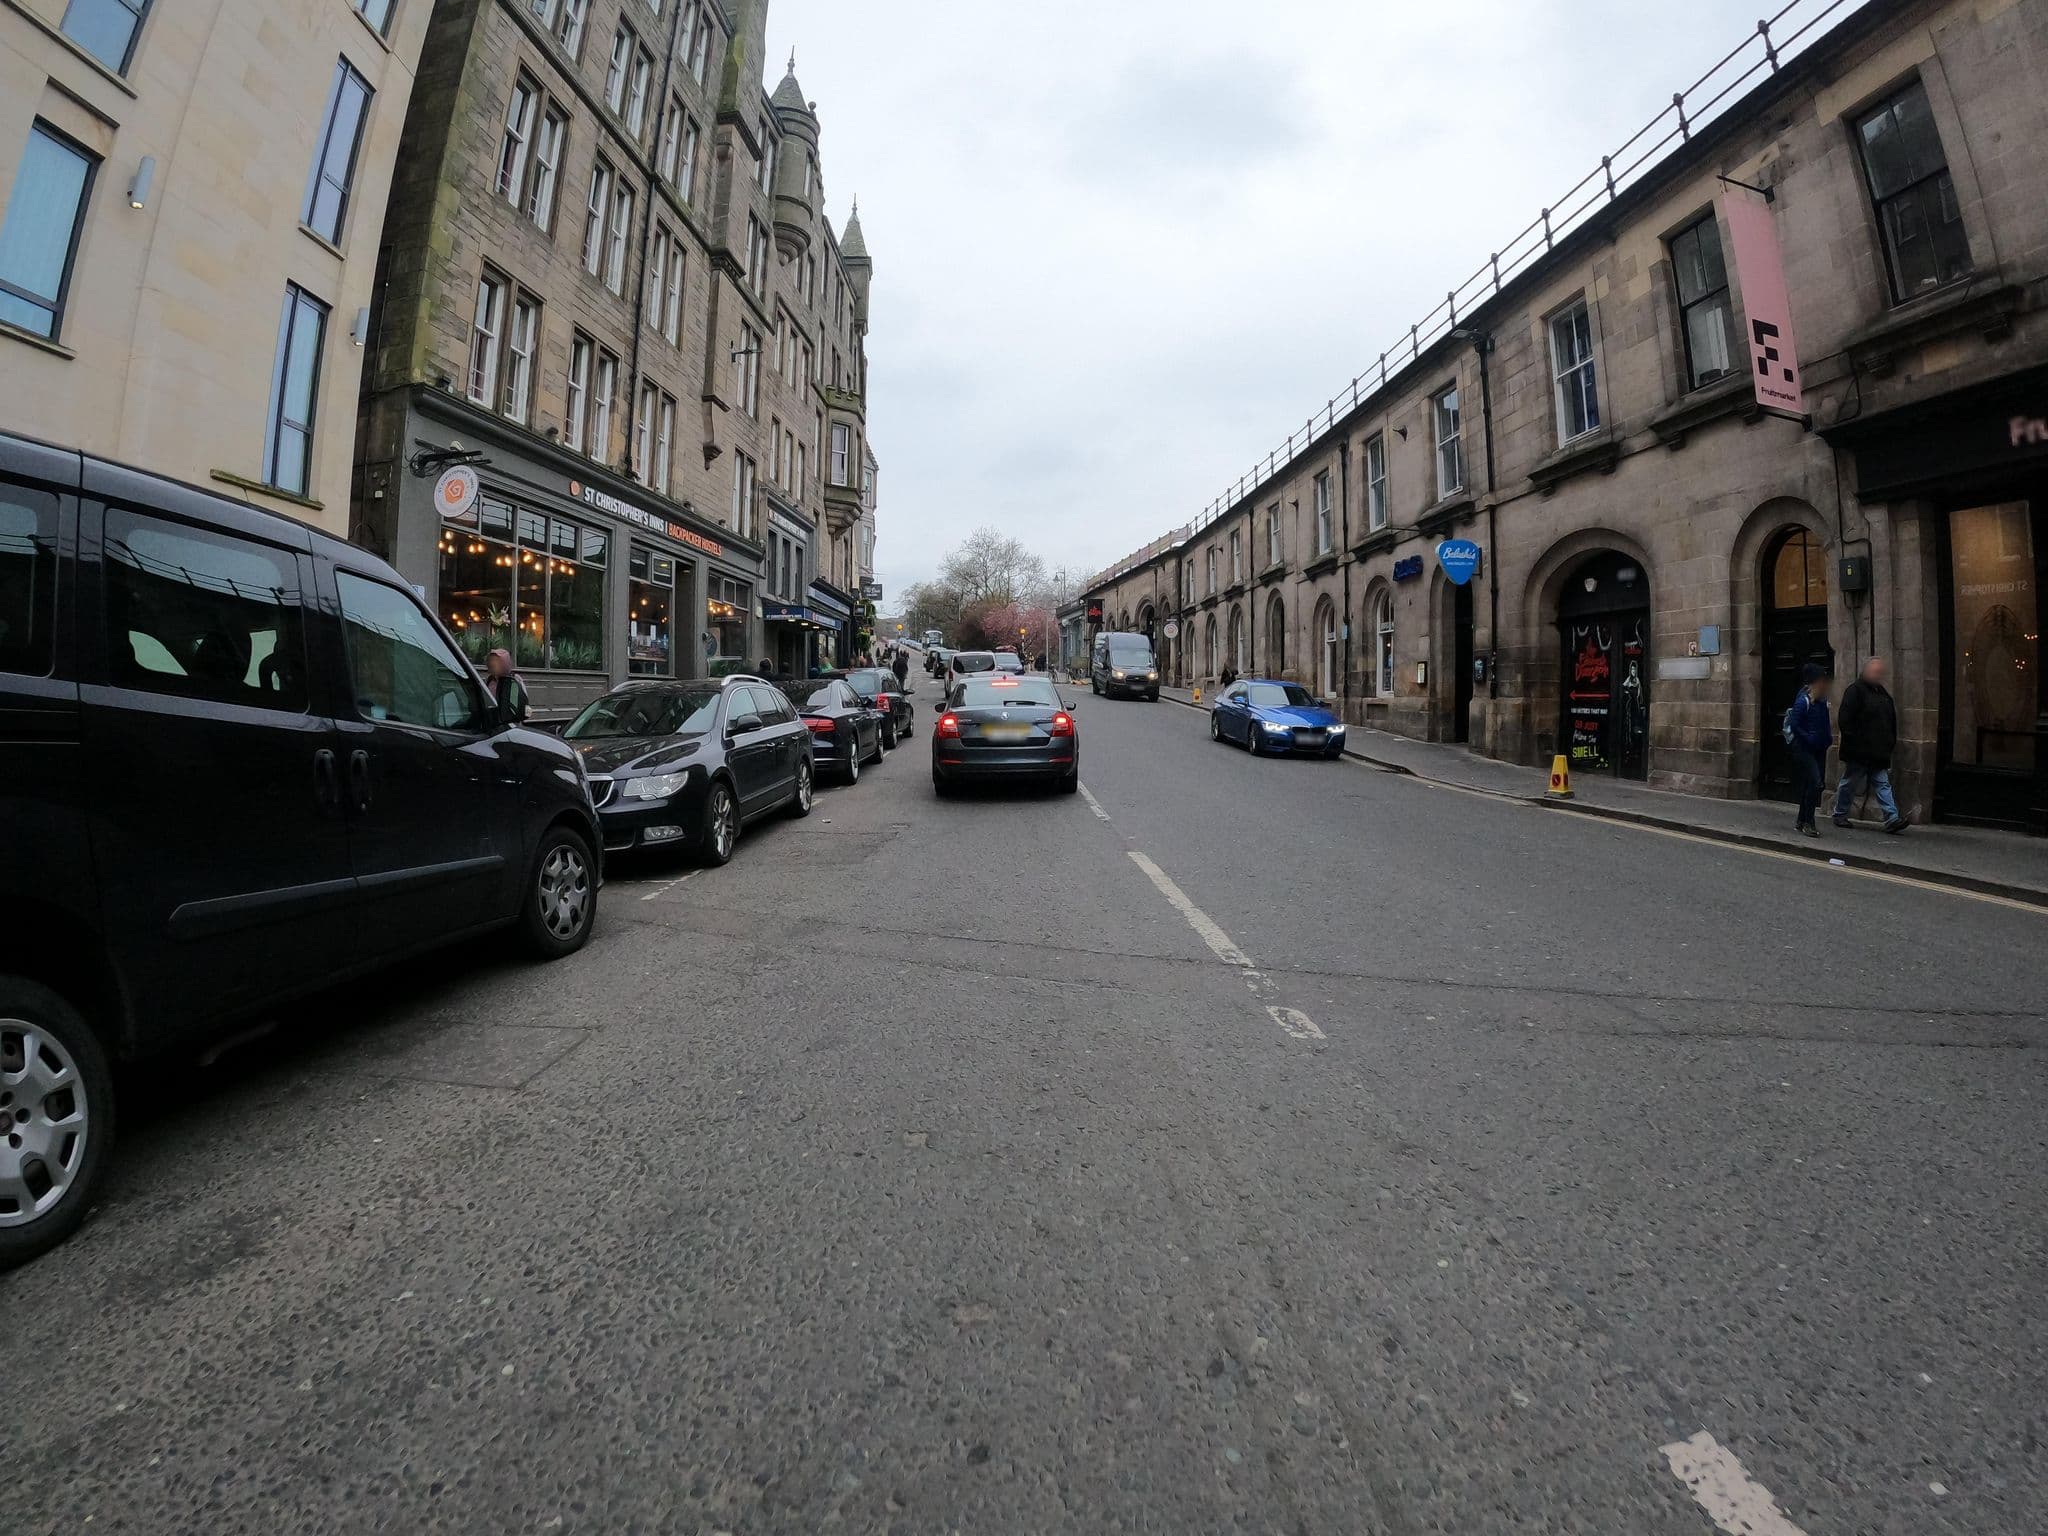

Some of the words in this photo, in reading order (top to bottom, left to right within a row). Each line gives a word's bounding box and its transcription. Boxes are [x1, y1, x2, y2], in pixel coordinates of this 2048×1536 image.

[1761, 386, 1796, 402] Fruitmarket
[584, 486, 595, 503] ST
[595, 491, 649, 526] CHRISTOPHER'S
[649, 514, 665, 532] INNS
[668, 522, 702, 549] BACKPACKER
[702, 537, 722, 557] HOSTELS
[1572, 744, 1599, 758] SMELL
